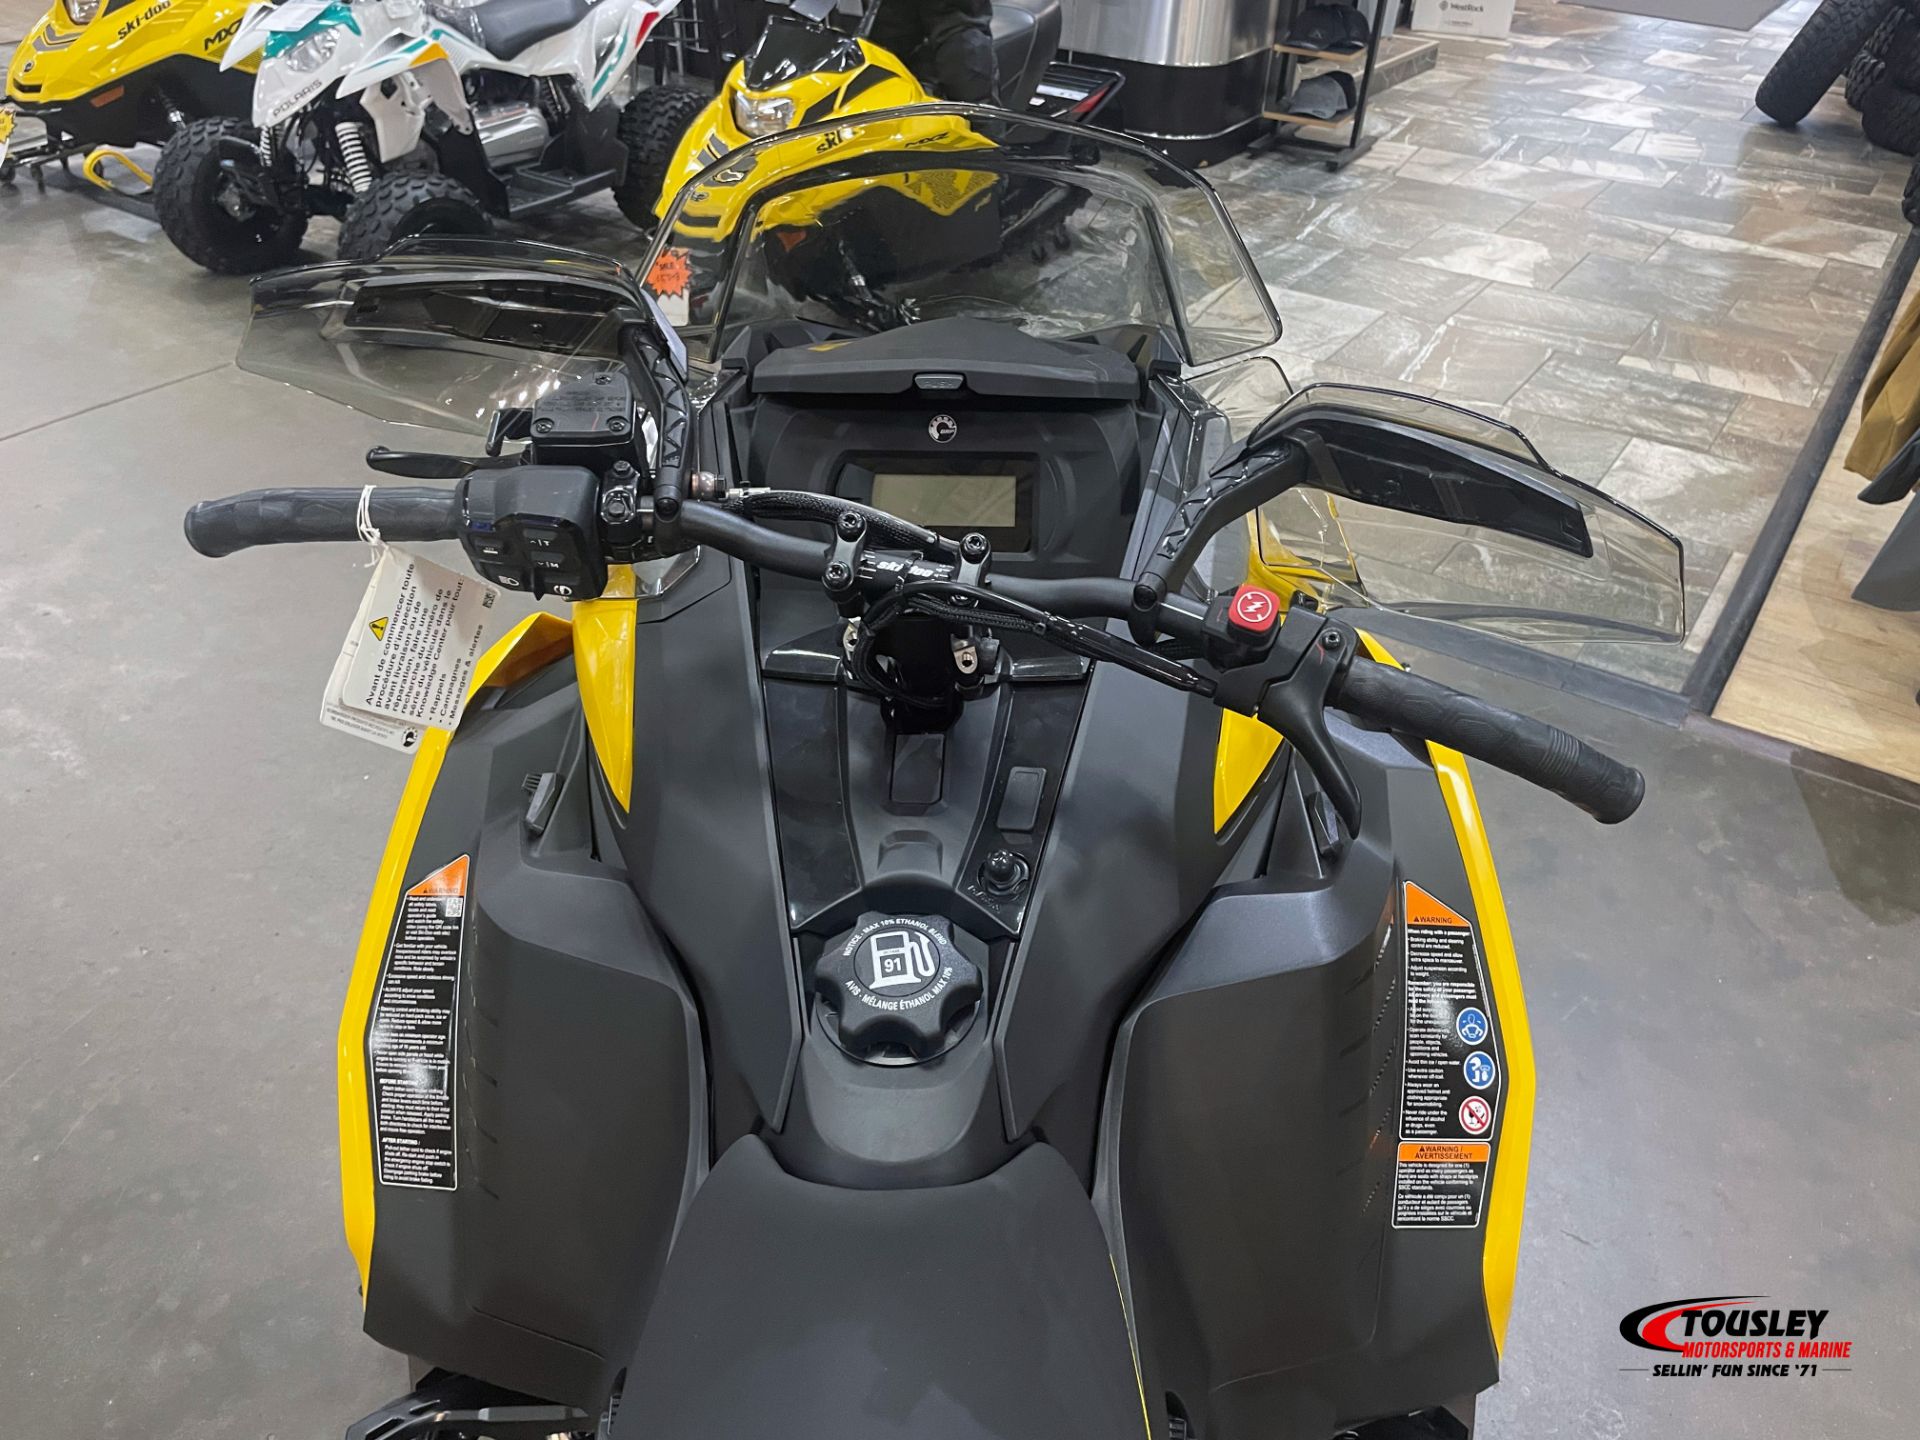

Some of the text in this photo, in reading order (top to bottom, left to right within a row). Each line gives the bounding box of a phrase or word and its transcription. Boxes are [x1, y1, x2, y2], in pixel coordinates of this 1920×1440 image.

[272, 79, 323, 117] POLARIS
[366, 563, 415, 705] Avant de commencer toute
[375, 585, 418, 708] procédure d'inspection
[384, 601, 422, 709] avant livraison ou de
[400, 587, 443, 713] recherche du numéro de
[409, 589, 452, 715] série du véhicule dans le
[410, 629, 421, 652] faire
[419, 607, 428, 627] une
[416, 663, 439, 718] Knowledge
[434, 628, 448, 660] Center
[446, 602, 458, 626] pour
[439, 657, 463, 717] Campagnes
[449, 670, 470, 719] Messages
[842, 934, 860, 956] NOTICE
[862, 922, 880, 933] MAX
[896, 918, 928, 930] ETHANOL
[928, 928, 947, 944] BLEND
[884, 957, 902, 973] 91
[845, 980, 861, 996] AVIS
[862, 994, 898, 1010] MÉLANGE
[900, 992, 935, 1010] ÉTHANOL
[932, 979, 948, 994] MAX
